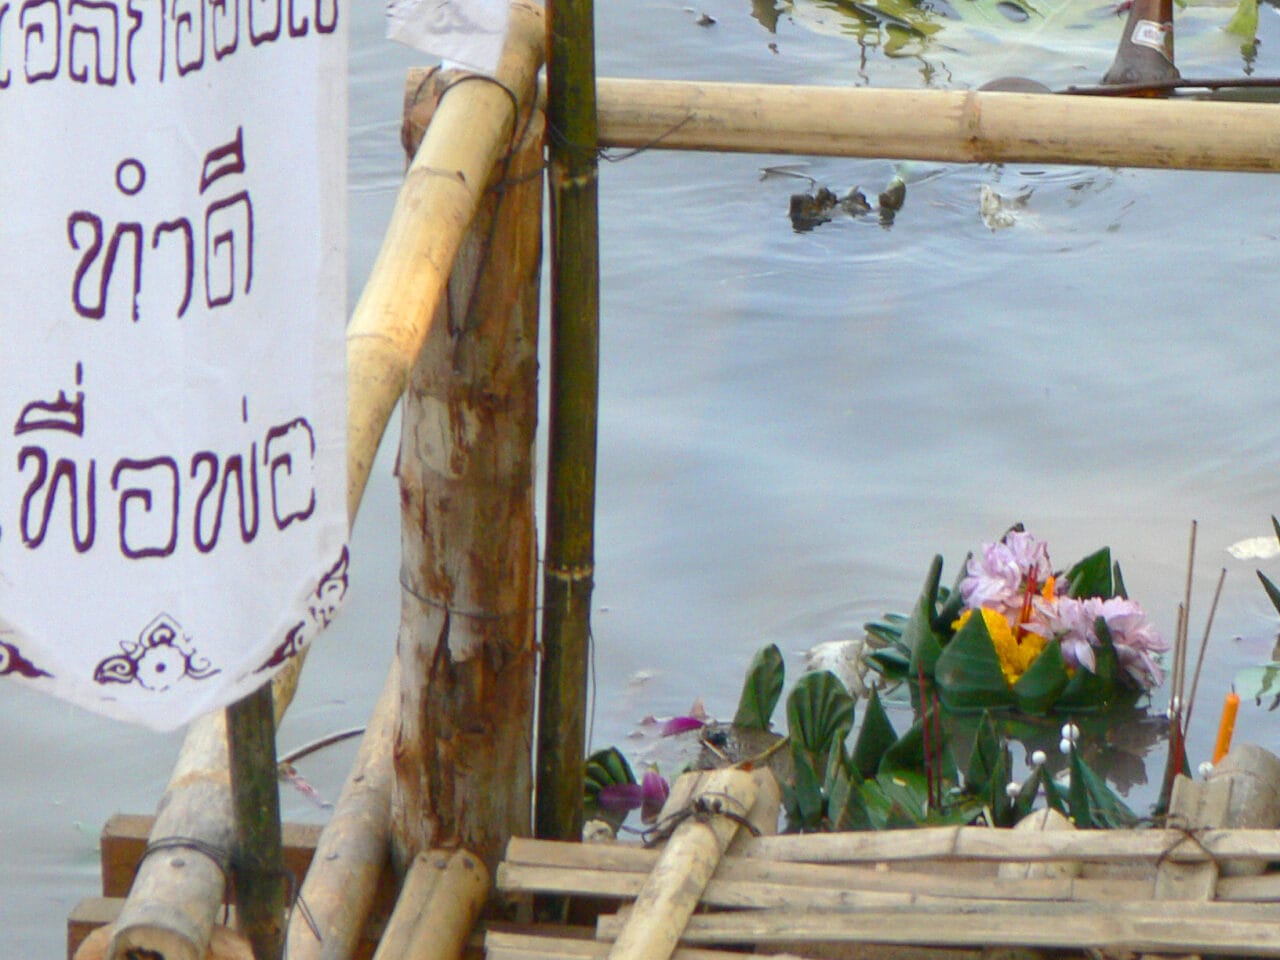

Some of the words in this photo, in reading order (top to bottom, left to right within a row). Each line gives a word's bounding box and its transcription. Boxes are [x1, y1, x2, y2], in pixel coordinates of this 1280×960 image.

[68, 128, 253, 321] ทำดี
[0, 363, 315, 559] พื่อพ่อ
